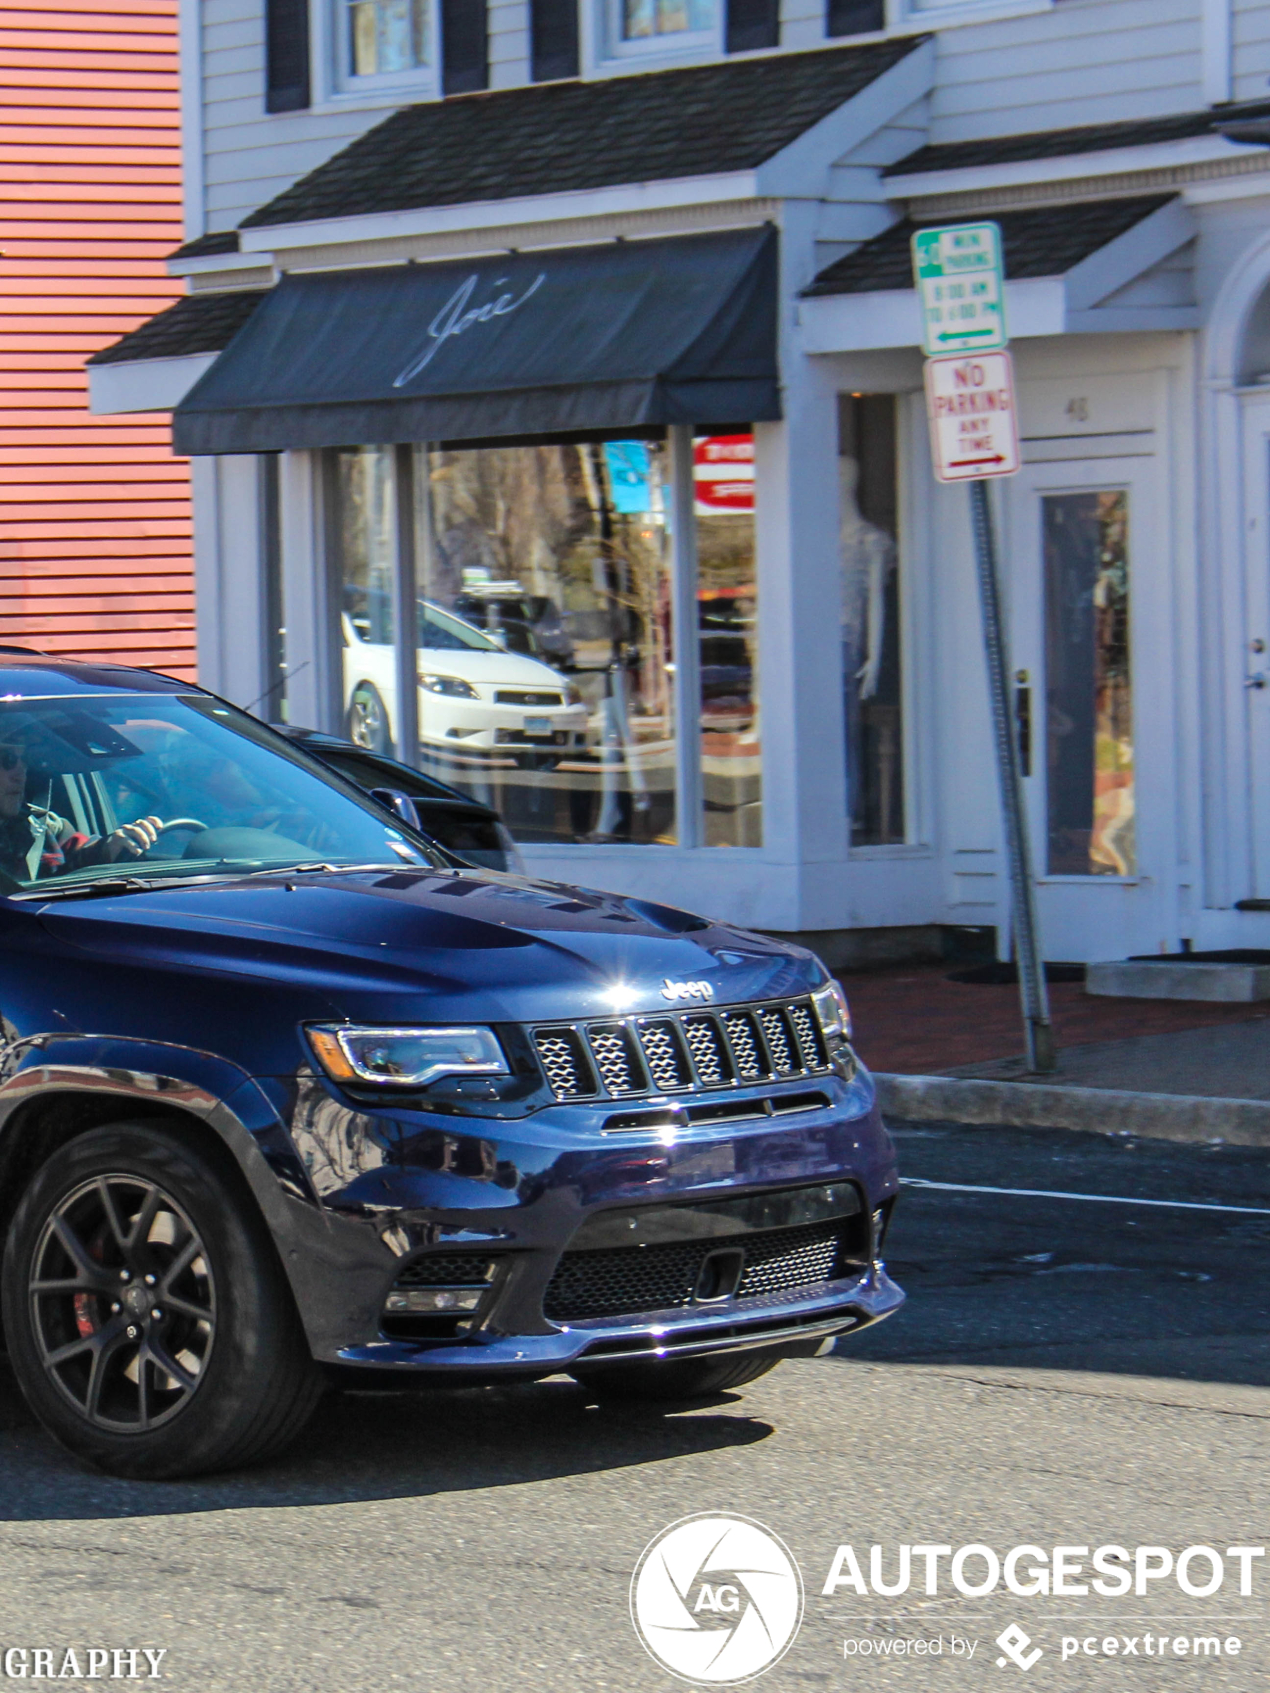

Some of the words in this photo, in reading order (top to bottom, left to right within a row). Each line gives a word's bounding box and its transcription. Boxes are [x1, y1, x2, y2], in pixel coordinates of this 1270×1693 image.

[392, 273, 547, 388] Joie
[953, 364, 985, 389] NO
[934, 388, 1010, 418] PARKING
[958, 417, 990, 435] ANY
[958, 434, 994, 453] TIME
[661, 978, 714, 1002] Jeep
